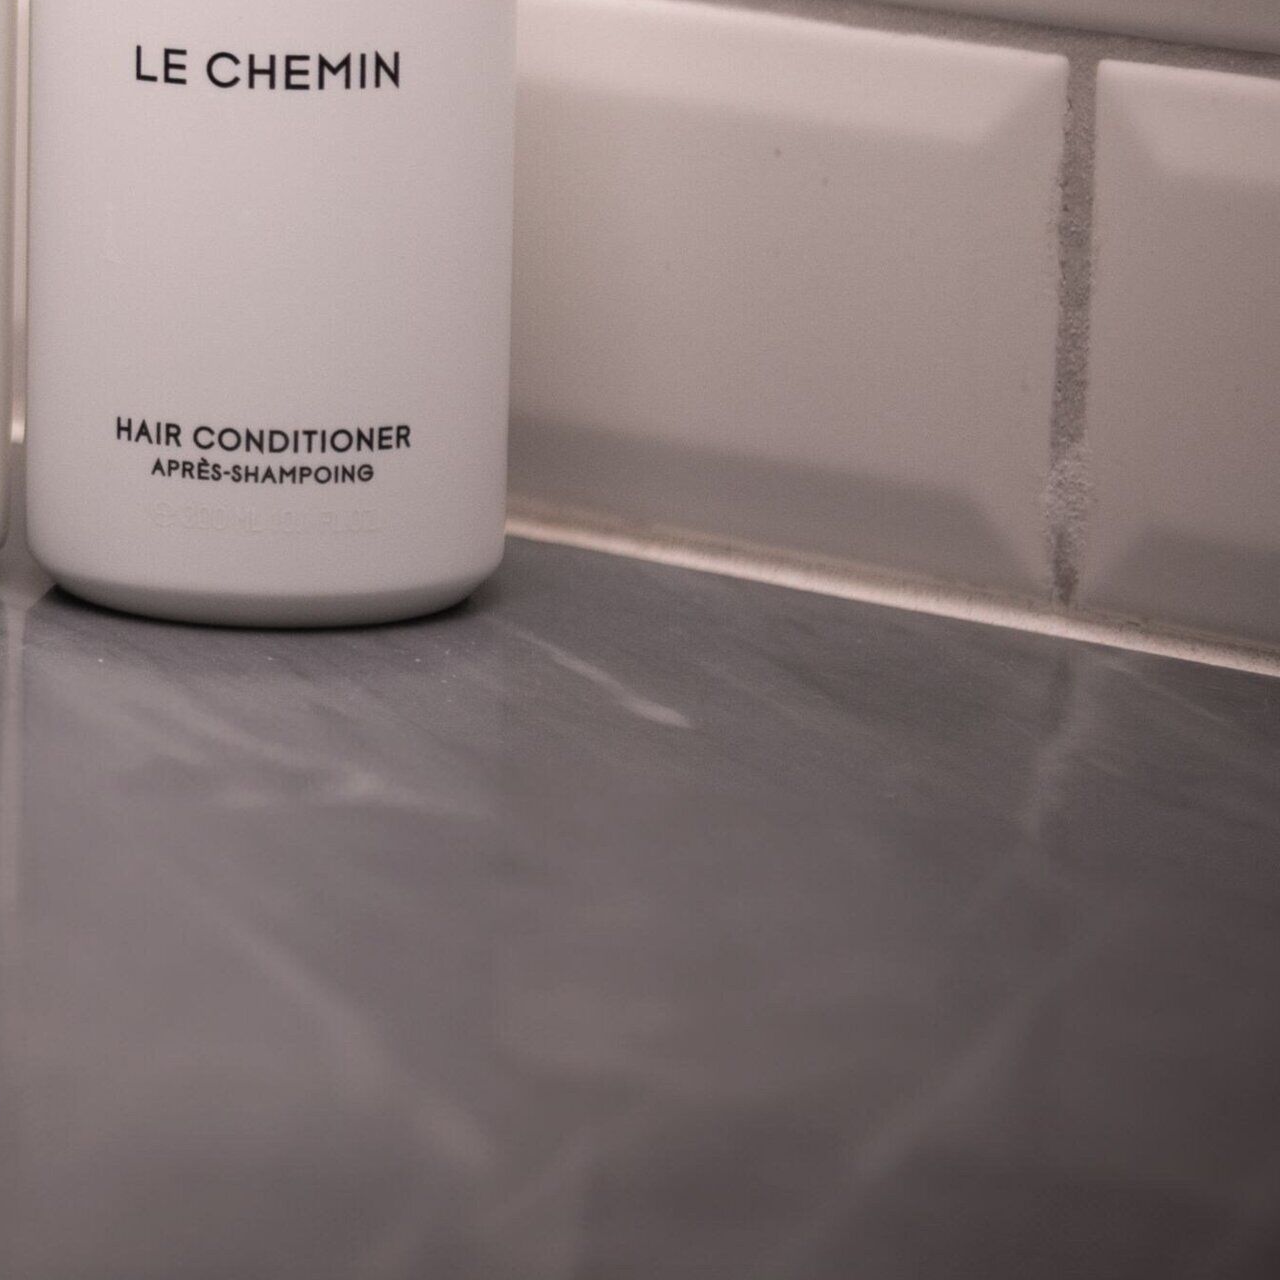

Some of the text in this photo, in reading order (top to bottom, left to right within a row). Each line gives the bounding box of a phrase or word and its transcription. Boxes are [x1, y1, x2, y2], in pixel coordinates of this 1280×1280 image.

[134, 44, 401, 91] LE CHEMIN
[115, 416, 412, 454] HAIR CONDITIONER
[150, 457, 376, 486] APRÈS-SHAMPOING
